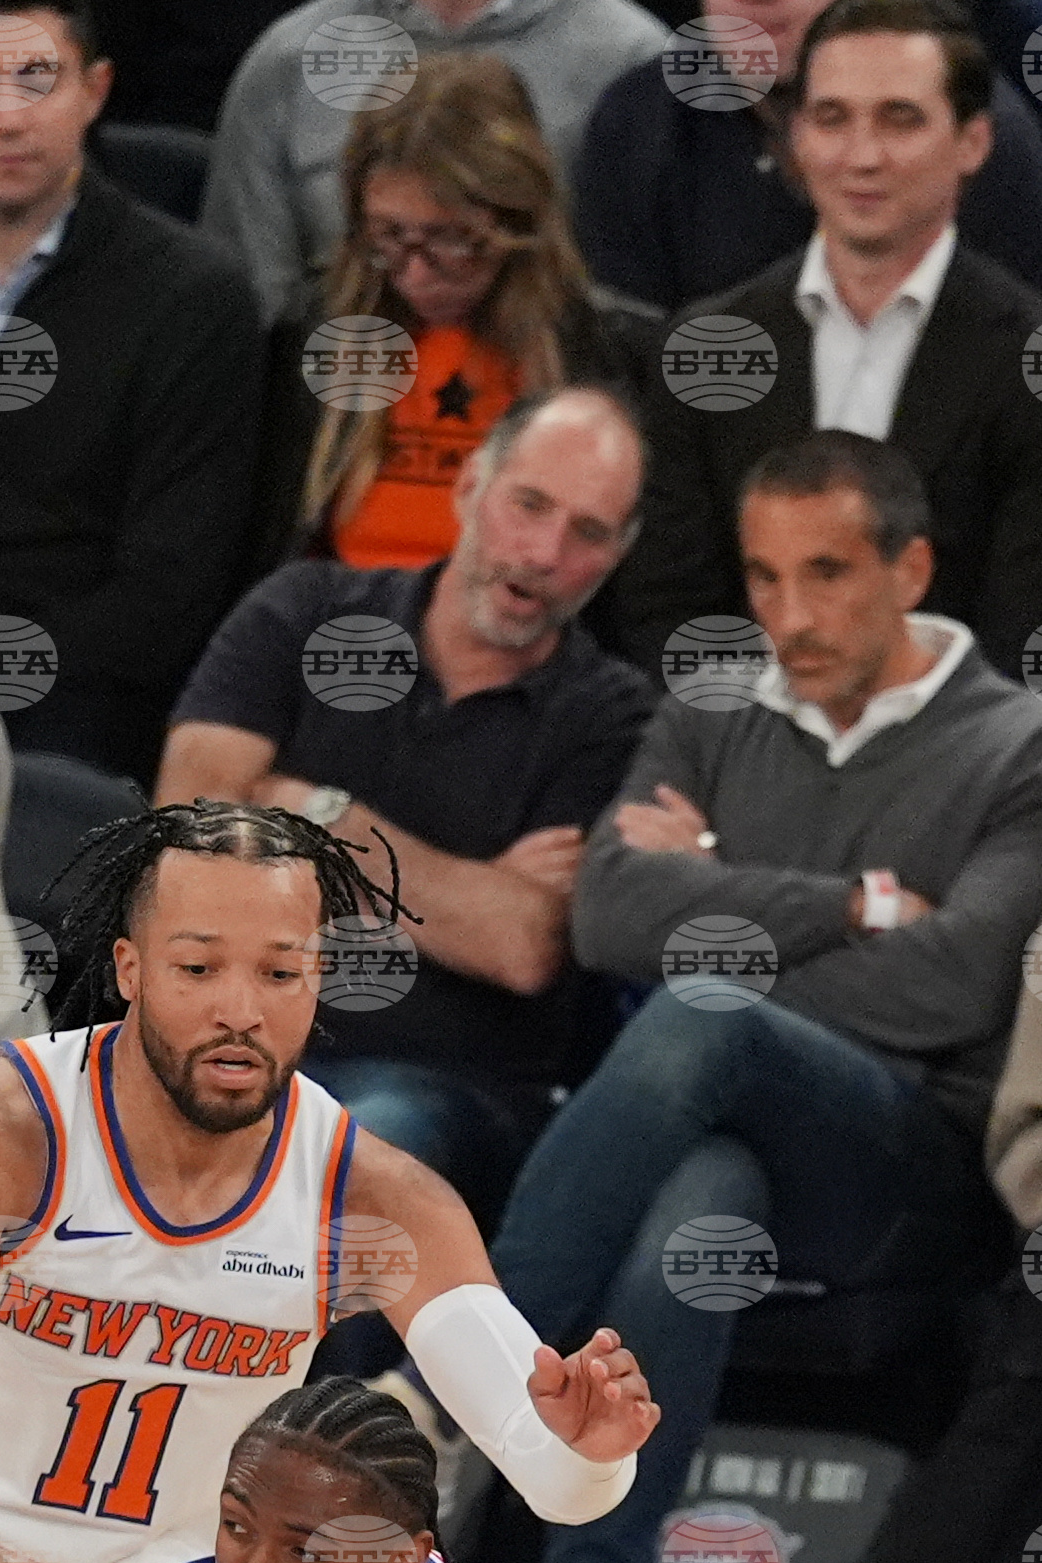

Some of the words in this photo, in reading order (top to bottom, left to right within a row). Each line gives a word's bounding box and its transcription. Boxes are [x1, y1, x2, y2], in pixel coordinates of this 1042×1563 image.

[222, 1258, 253, 1273] abu
[256, 1261, 305, 1279] dhabi
[147, 1304, 310, 1378] YORK
[32, 1379, 187, 1525] 11
